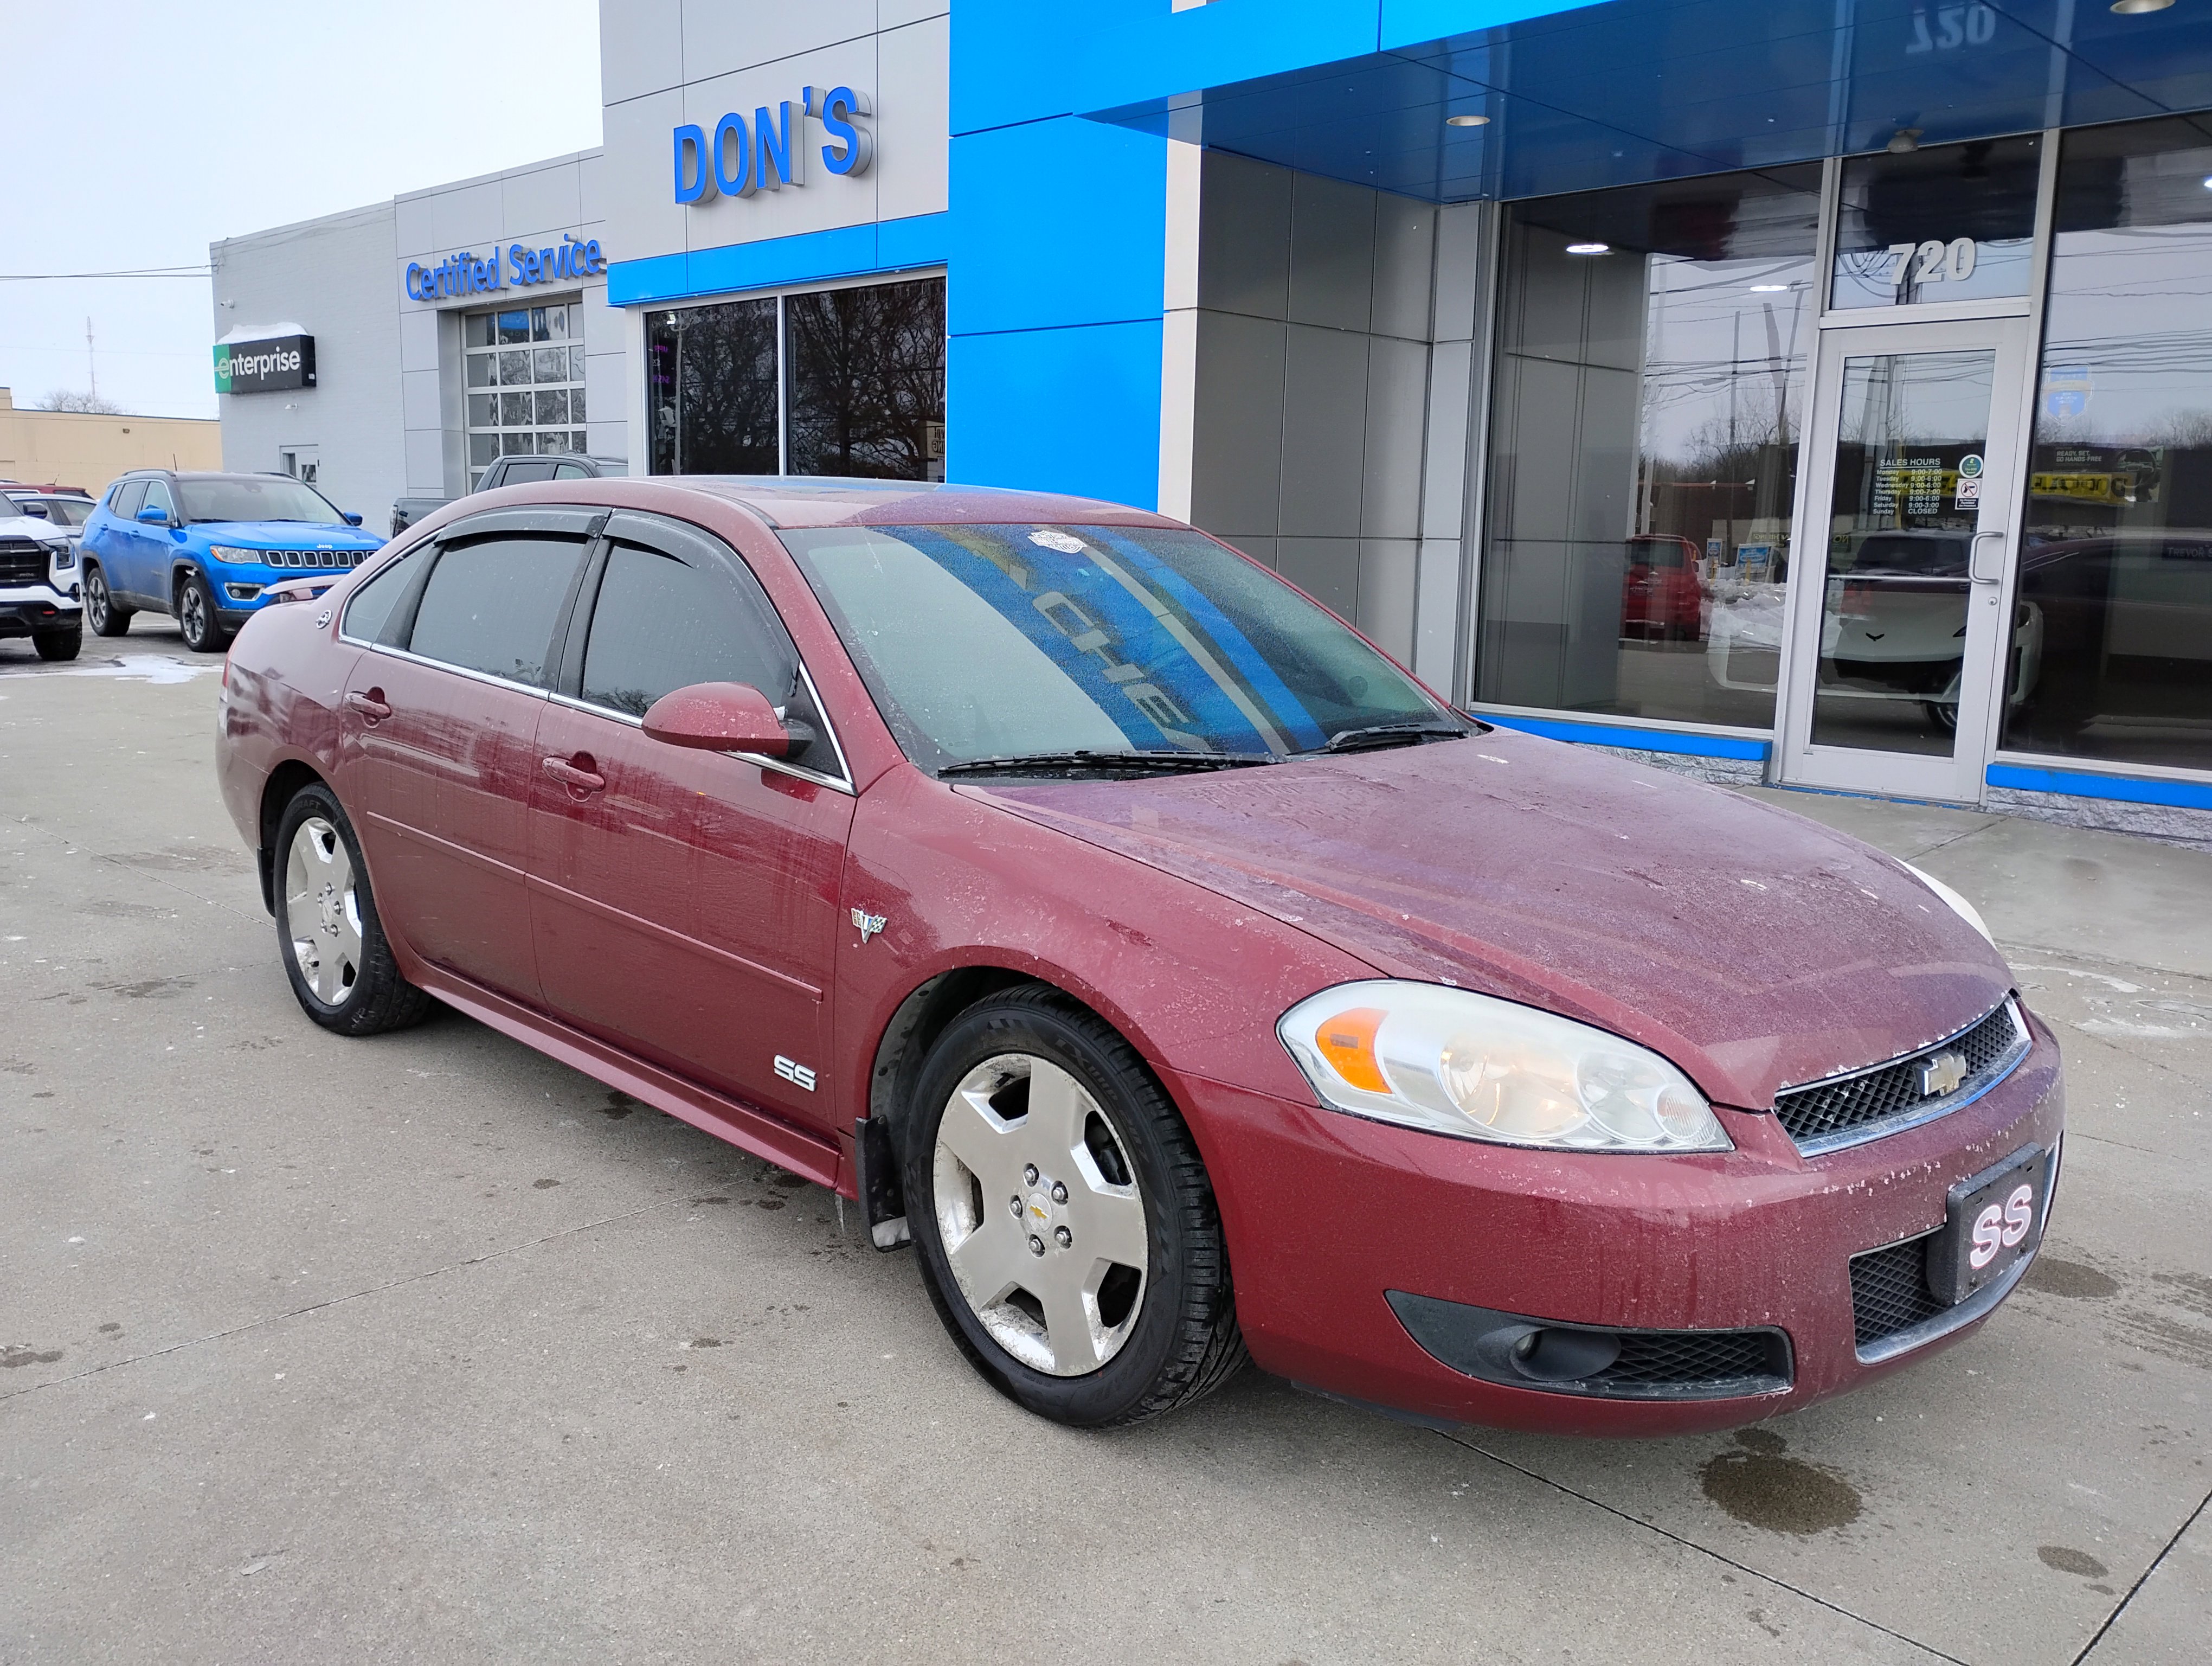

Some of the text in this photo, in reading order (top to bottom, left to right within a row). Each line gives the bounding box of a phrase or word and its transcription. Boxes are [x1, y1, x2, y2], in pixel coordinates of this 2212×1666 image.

[673, 86, 867, 204] DON'S
[406, 233, 603, 302] Certified Service
[1888, 237, 1976, 285] 720
[215, 346, 301, 380] enterprise
[1910, 458, 1941, 466] HOURS
[2167, 547, 2204, 558] TREVOR
[774, 1054, 816, 1092] SS
[1969, 1184, 2033, 1270] SS
